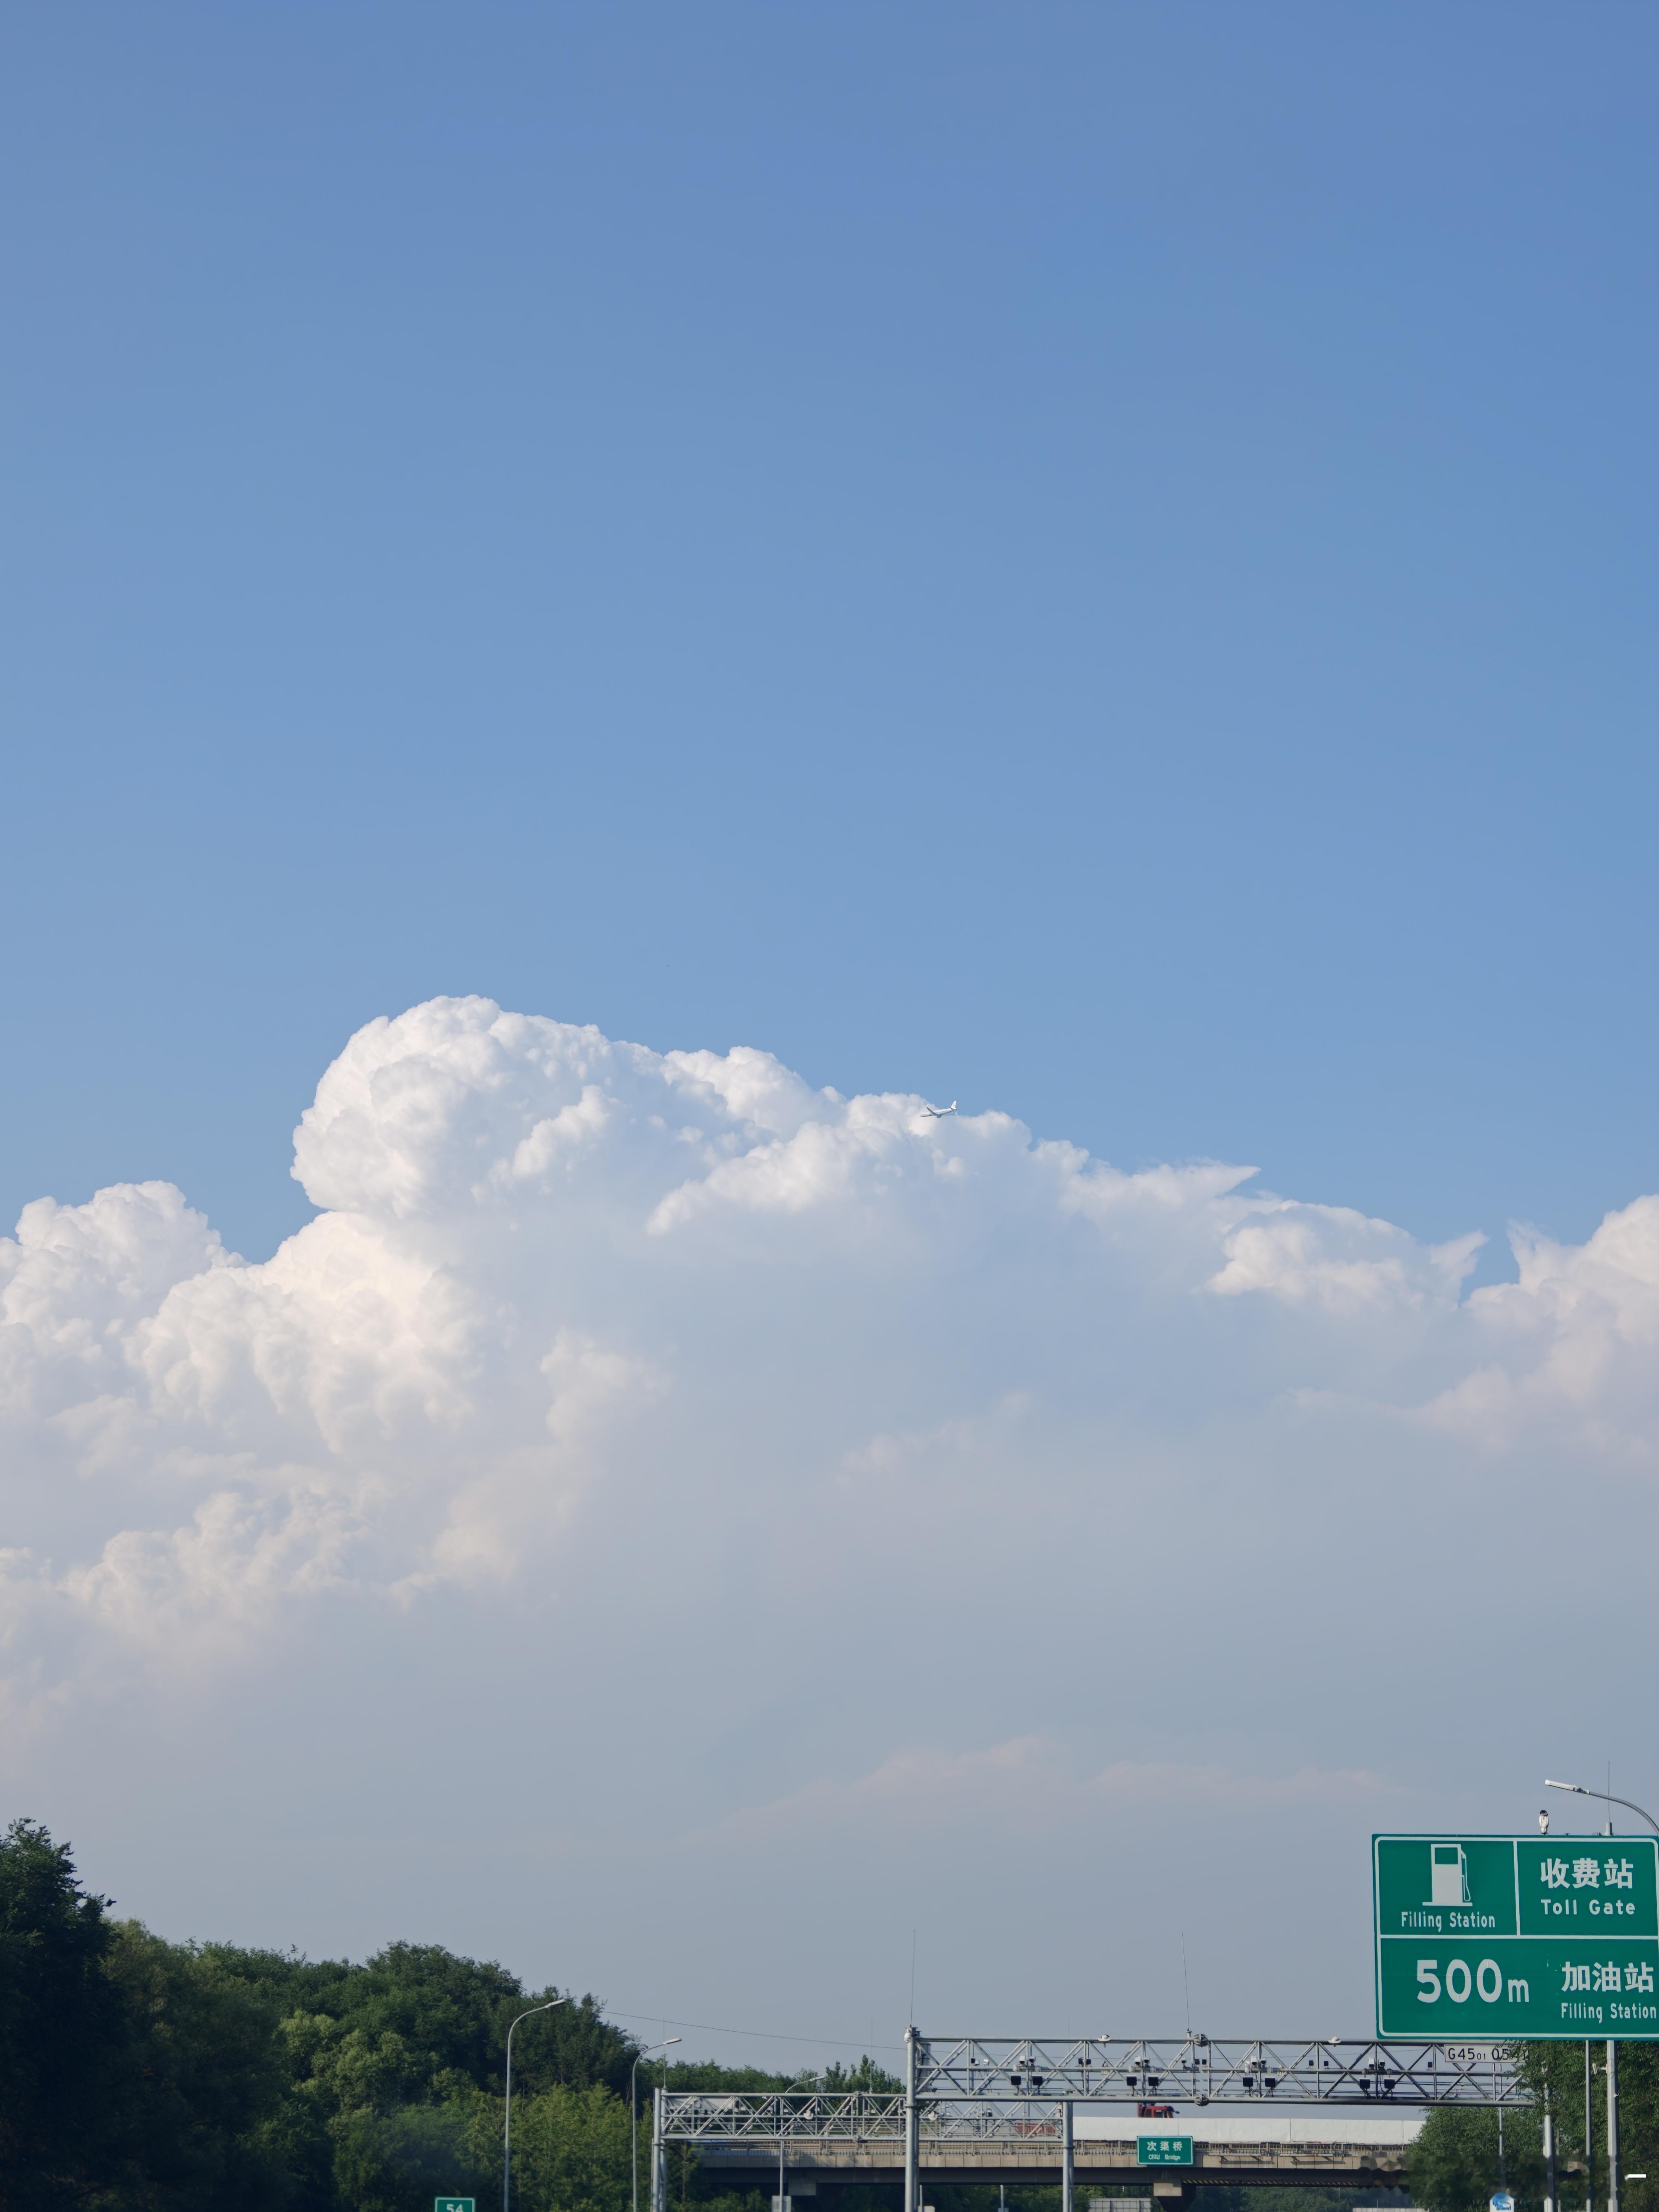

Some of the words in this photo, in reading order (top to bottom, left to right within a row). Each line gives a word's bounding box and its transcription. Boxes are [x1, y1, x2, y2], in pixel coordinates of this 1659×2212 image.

[1540, 1858, 1633, 1889] 收费站
[1541, 1899, 1577, 1914] Toll
[1589, 1899, 1635, 1915] Gate
[1401, 1911, 1441, 1932] Filling
[1449, 1911, 1495, 1928] Station
[1417, 1959, 1529, 2003] 500m
[1561, 1961, 1654, 1993] 加油站
[1561, 2002, 1602, 2024] Filling
[1610, 2003, 1656, 2019] Station
[1147, 2141, 1183, 2152] 次渠桥
